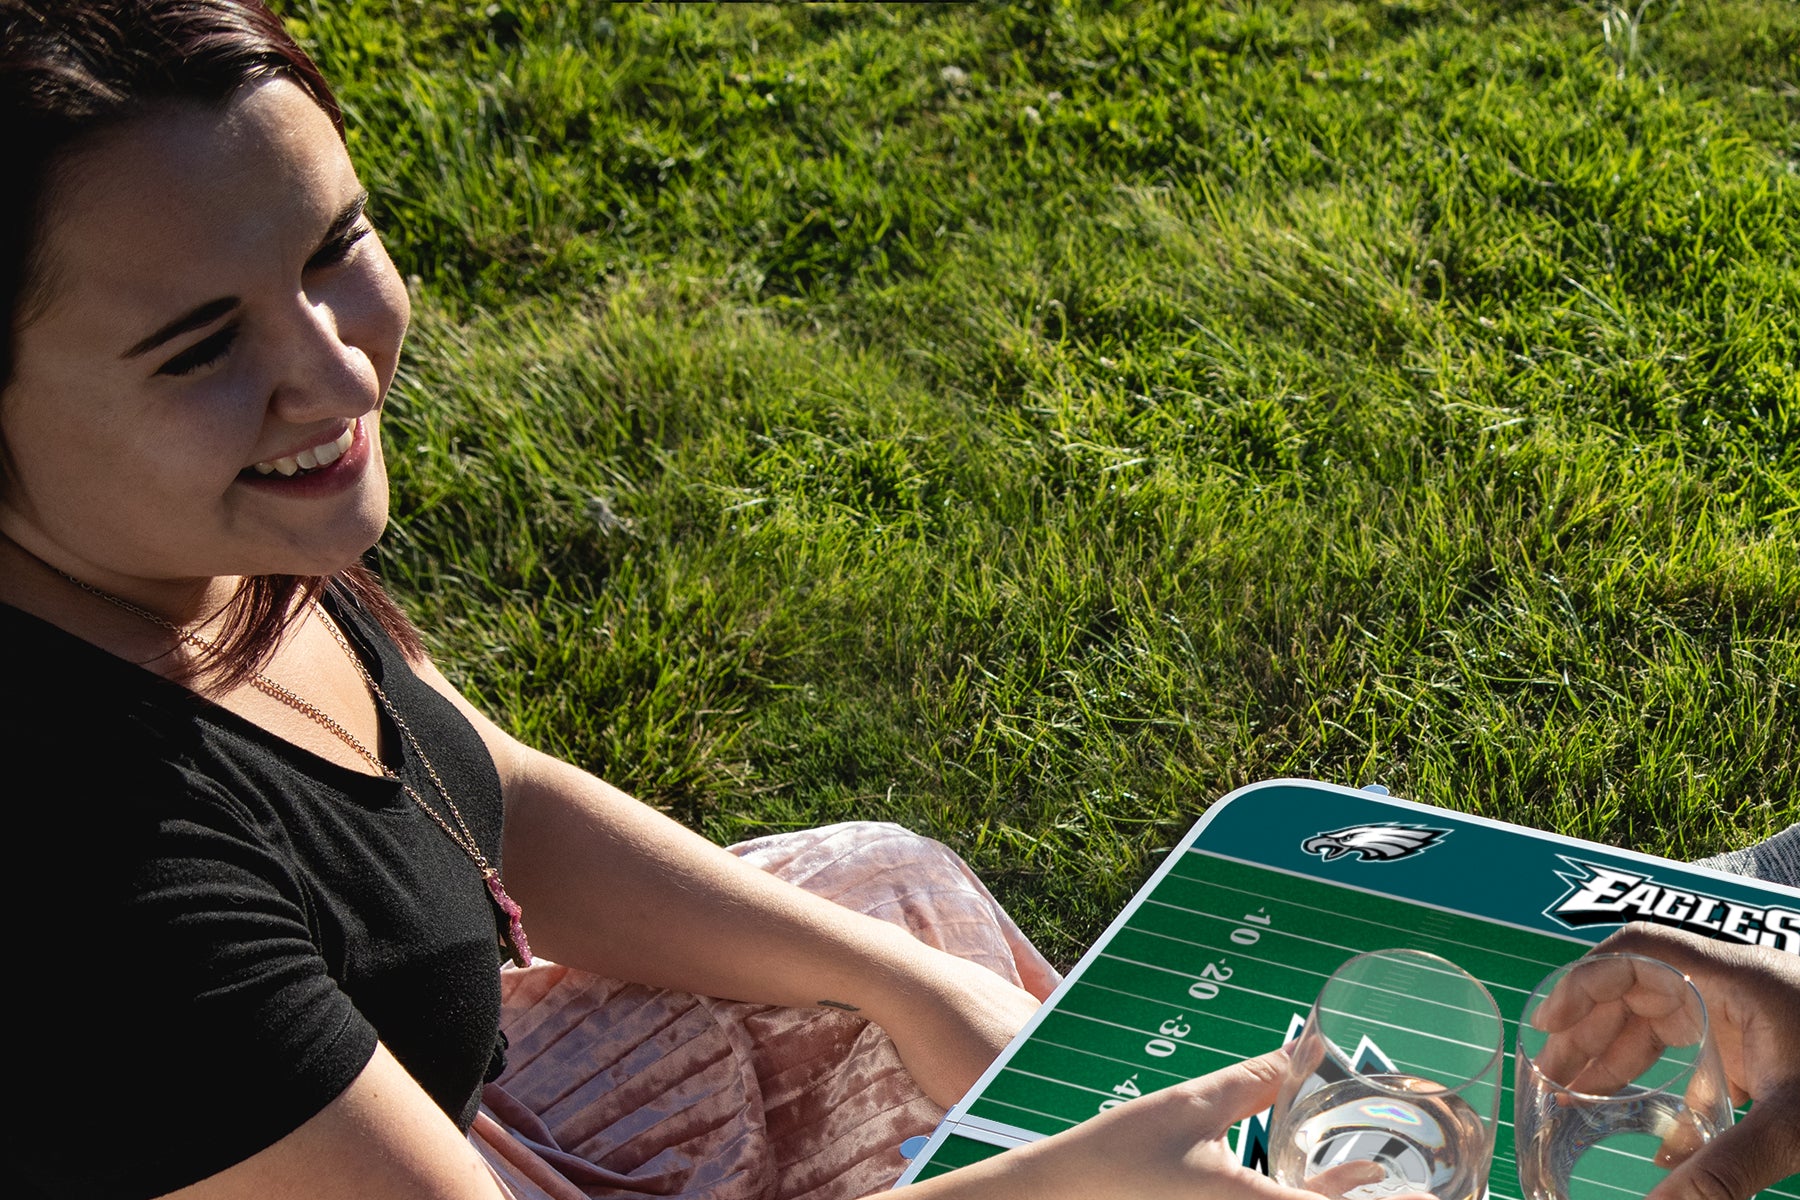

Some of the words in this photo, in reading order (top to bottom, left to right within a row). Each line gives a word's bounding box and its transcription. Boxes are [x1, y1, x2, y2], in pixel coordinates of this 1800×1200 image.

[1230, 912, 1272, 945] 10
[1188, 961, 1234, 1000] 20
[1145, 1018, 1191, 1058] 30
